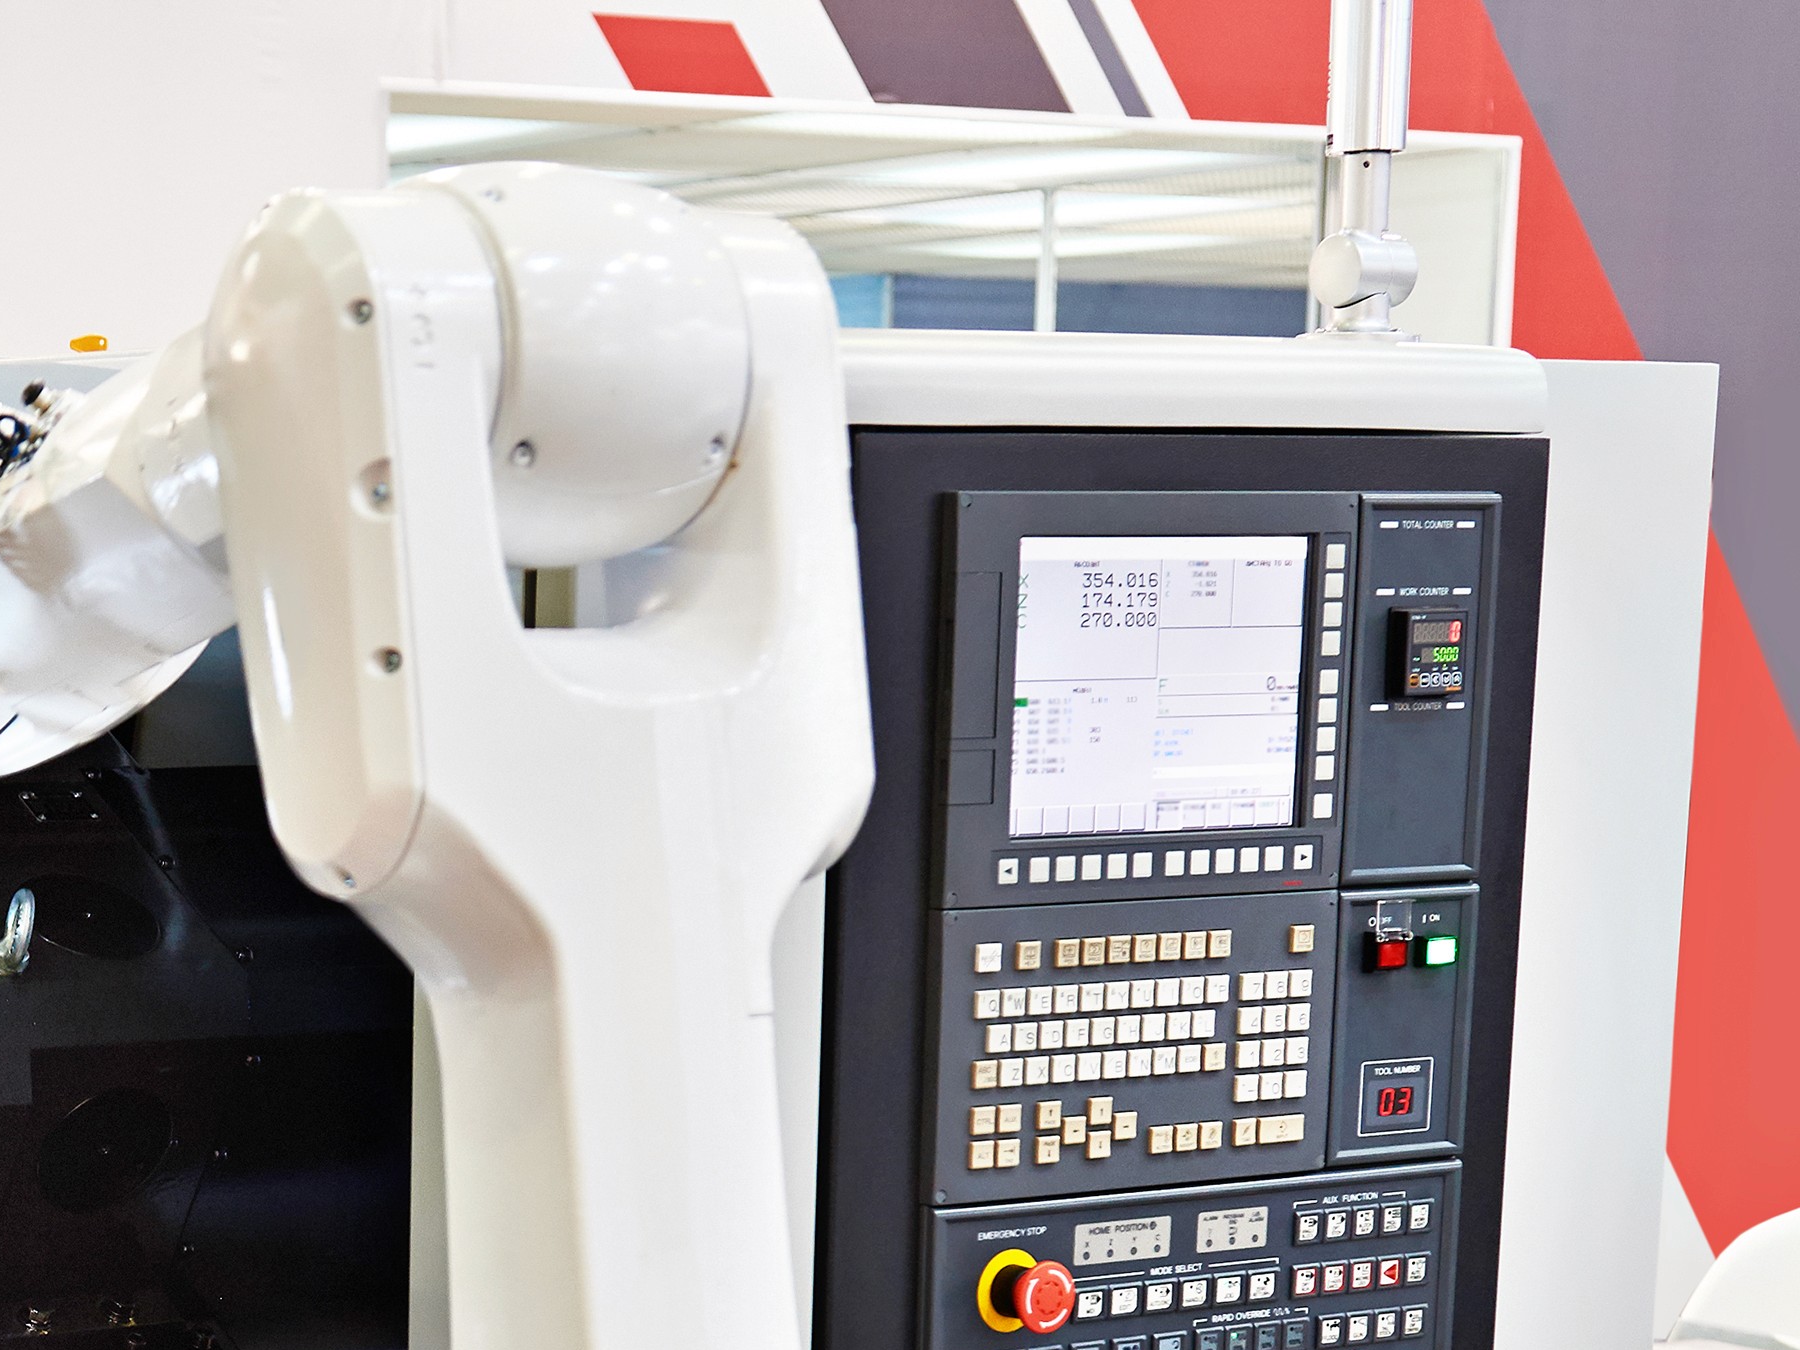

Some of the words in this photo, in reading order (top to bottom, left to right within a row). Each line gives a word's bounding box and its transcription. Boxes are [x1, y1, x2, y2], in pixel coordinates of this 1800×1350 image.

[1402, 520, 1422, 529] TOTAL
[1424, 520, 1454, 529] COUNTER
[1082, 572, 1159, 588] 354.016
[1400, 588, 1418, 596] WORK
[1420, 587, 1450, 596] COUNTER
[1082, 592, 1158, 608] 174.179
[1080, 612, 1157, 628] 270.000
[1433, 646, 1460, 662] 5000
[1394, 702, 1411, 711] TOOL
[1413, 702, 1442, 711] COUNTER
[1429, 914, 1440, 922] ON
[1218, 984, 1226, 996] P
[1253, 982, 1260, 994] 7
[1276, 981, 1285, 993] 8
[1301, 980, 1308, 992] 9
[1067, 994, 1076, 1006] R
[1093, 992, 1101, 1004] T
[1118, 991, 1126, 1003] Y
[1144, 990, 1151, 1001] U
[989, 1000, 998, 1012] Q
[1014, 997, 1024, 1010] W
[1042, 996, 1049, 1008] E
[1250, 1017, 1258, 1028] 4
[1275, 1014, 1283, 1027] 5
[1299, 1013, 1306, 1025] 6
[1130, 1025, 1138, 1038] H
[1180, 1022, 1188, 1034] K
[1205, 1020, 1212, 1032] L
[1026, 1032, 1035, 1045] S
[1052, 1030, 1060, 1043] D
[1078, 1028, 1086, 1041] F
[1103, 1027, 1112, 1039] G
[1000, 1034, 1008, 1046] A
[1250, 1051, 1255, 1062] 1
[1274, 1048, 1282, 1061] 2
[1297, 1046, 1306, 1059] 3
[1090, 1062, 1099, 1074] V
[1115, 1061, 1123, 1073] B
[1140, 1060, 1148, 1071] N
[1165, 1057, 1174, 1069] M
[1012, 1068, 1020, 1080] Z
[1038, 1066, 1046, 1078] X
[1064, 1064, 1072, 1076] C
[1374, 1066, 1392, 1076] TOOL
[1394, 1064, 1421, 1074] NUMBER
[1272, 1082, 1280, 1094] 0
[1378, 1087, 1412, 1117] 03
[1322, 1196, 1338, 1204] AUX
[1342, 1191, 1379, 1202] FUNCTION
[978, 1228, 1026, 1242] EMERGENCY
[1026, 1226, 1048, 1236] STOP
[1088, 1226, 1111, 1236] HOME
[1114, 1222, 1150, 1233] POSITION
[1150, 1266, 1173, 1276] MODE
[1174, 1263, 1202, 1274] SELECT
[1212, 1314, 1234, 1322] RAPID
[1235, 1308, 1270, 1320] OVERRIDE
